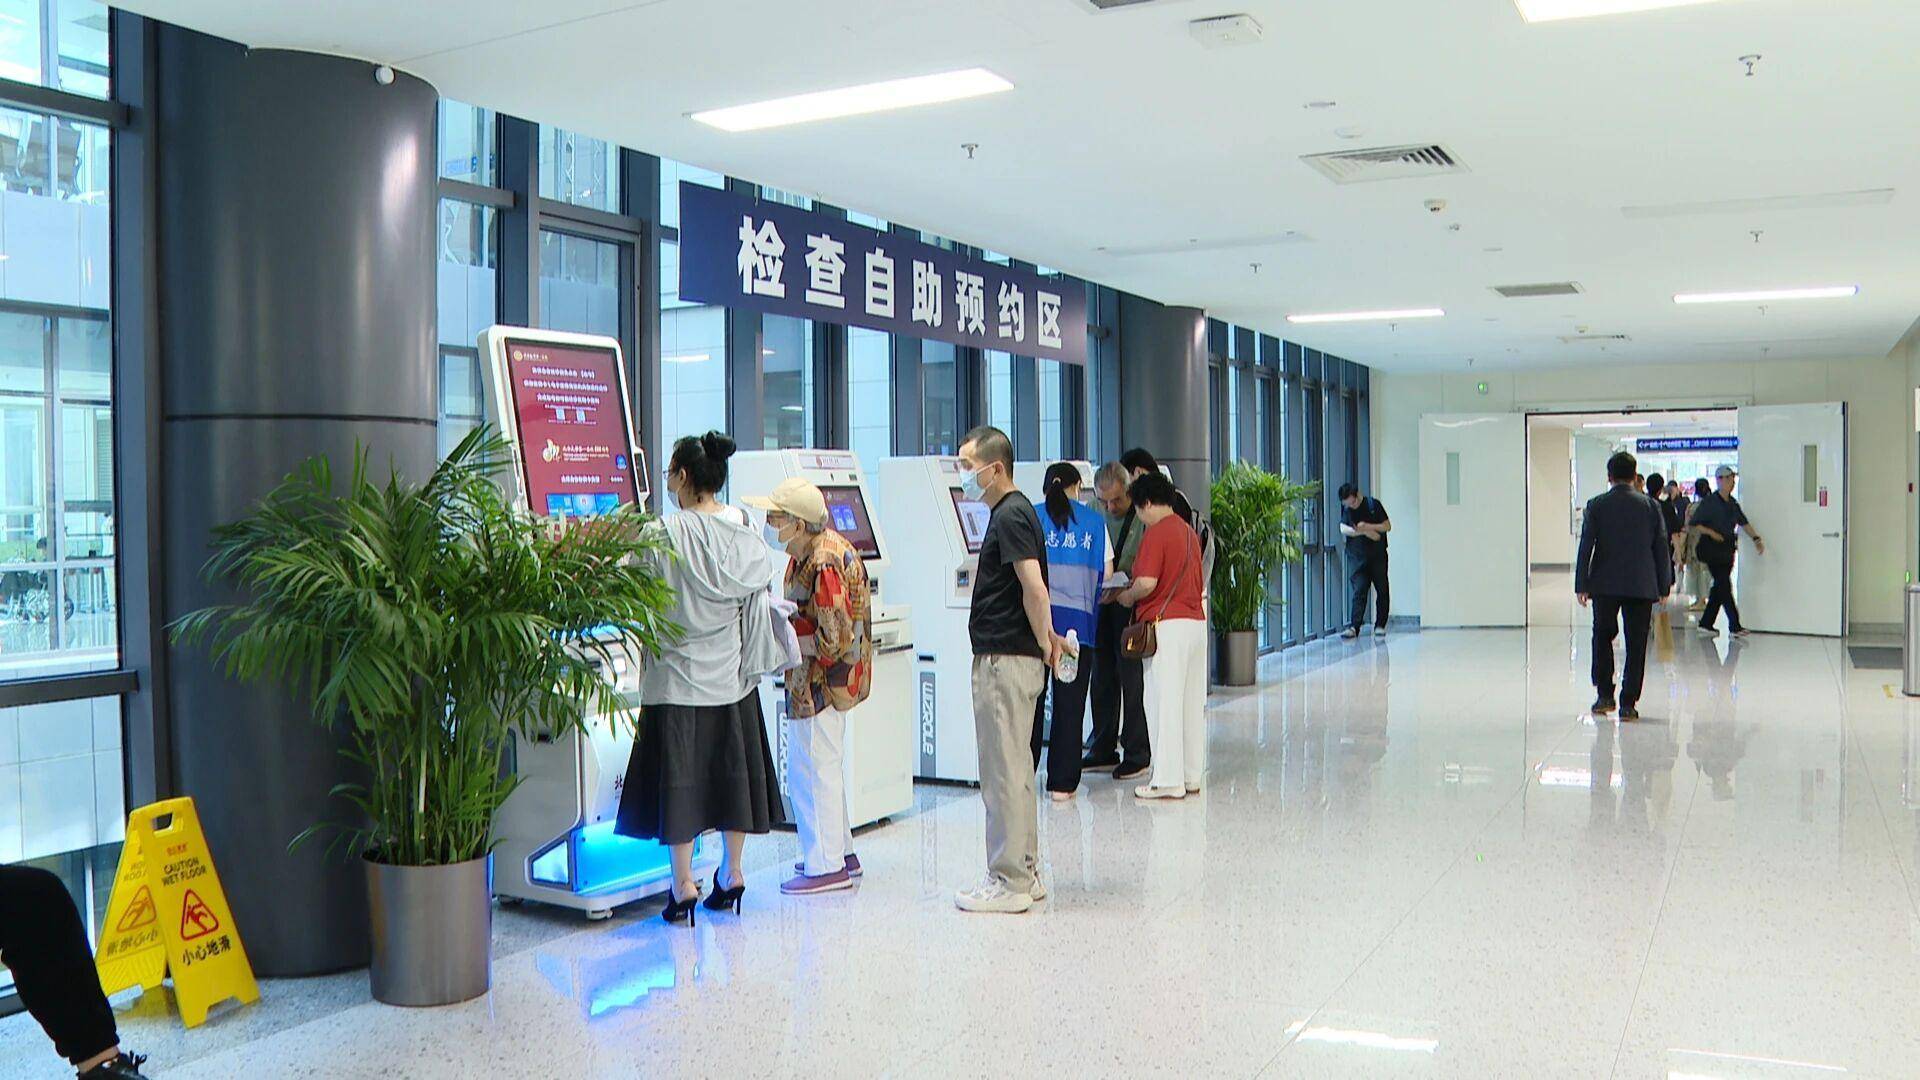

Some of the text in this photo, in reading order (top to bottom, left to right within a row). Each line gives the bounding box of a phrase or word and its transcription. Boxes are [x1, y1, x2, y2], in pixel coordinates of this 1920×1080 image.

[737, 214, 1062, 349] 检查自助预约区
[1045, 530, 1092, 551] 志愿者
[161, 865, 206, 887] WET FLOOR
[163, 857, 199, 874] CAUTION
[182, 934, 231, 967] 小心地滑
